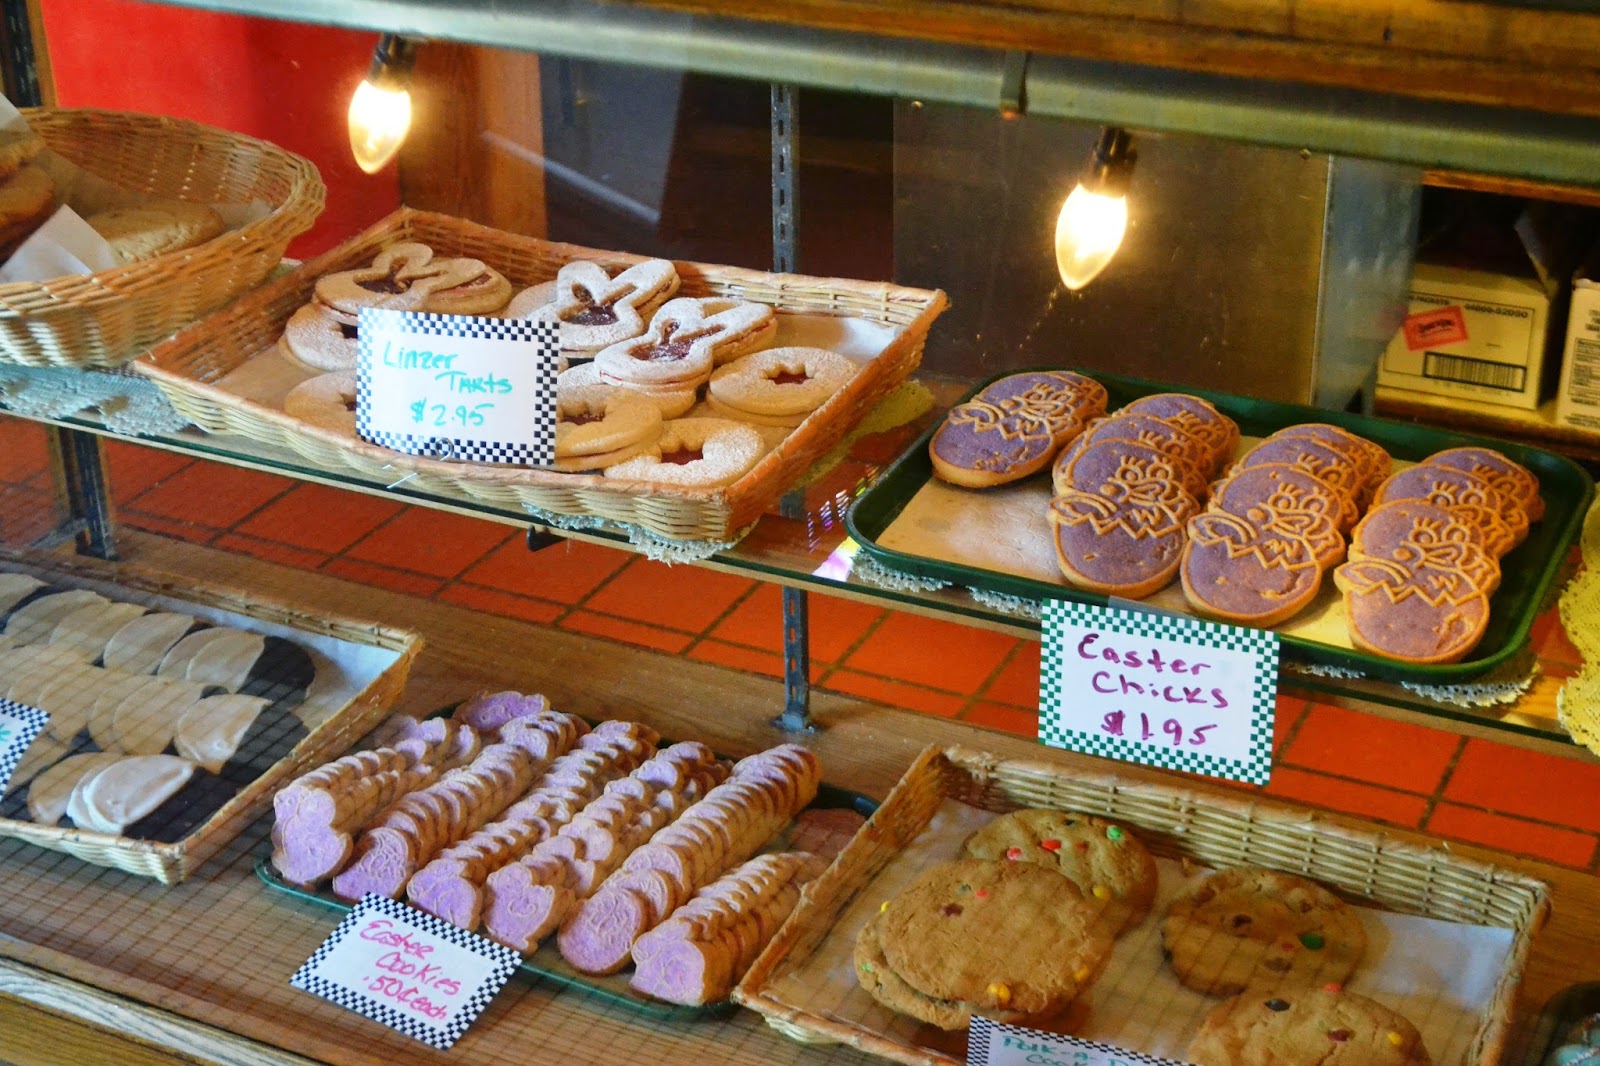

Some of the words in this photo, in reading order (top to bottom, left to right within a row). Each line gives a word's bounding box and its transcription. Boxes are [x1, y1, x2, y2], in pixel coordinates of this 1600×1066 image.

[383, 340, 458, 369] Linzer
[410, 397, 495, 426] $2.95
[1077, 633, 1211, 675] Easter
[1091, 671, 1229, 709] Chicks
